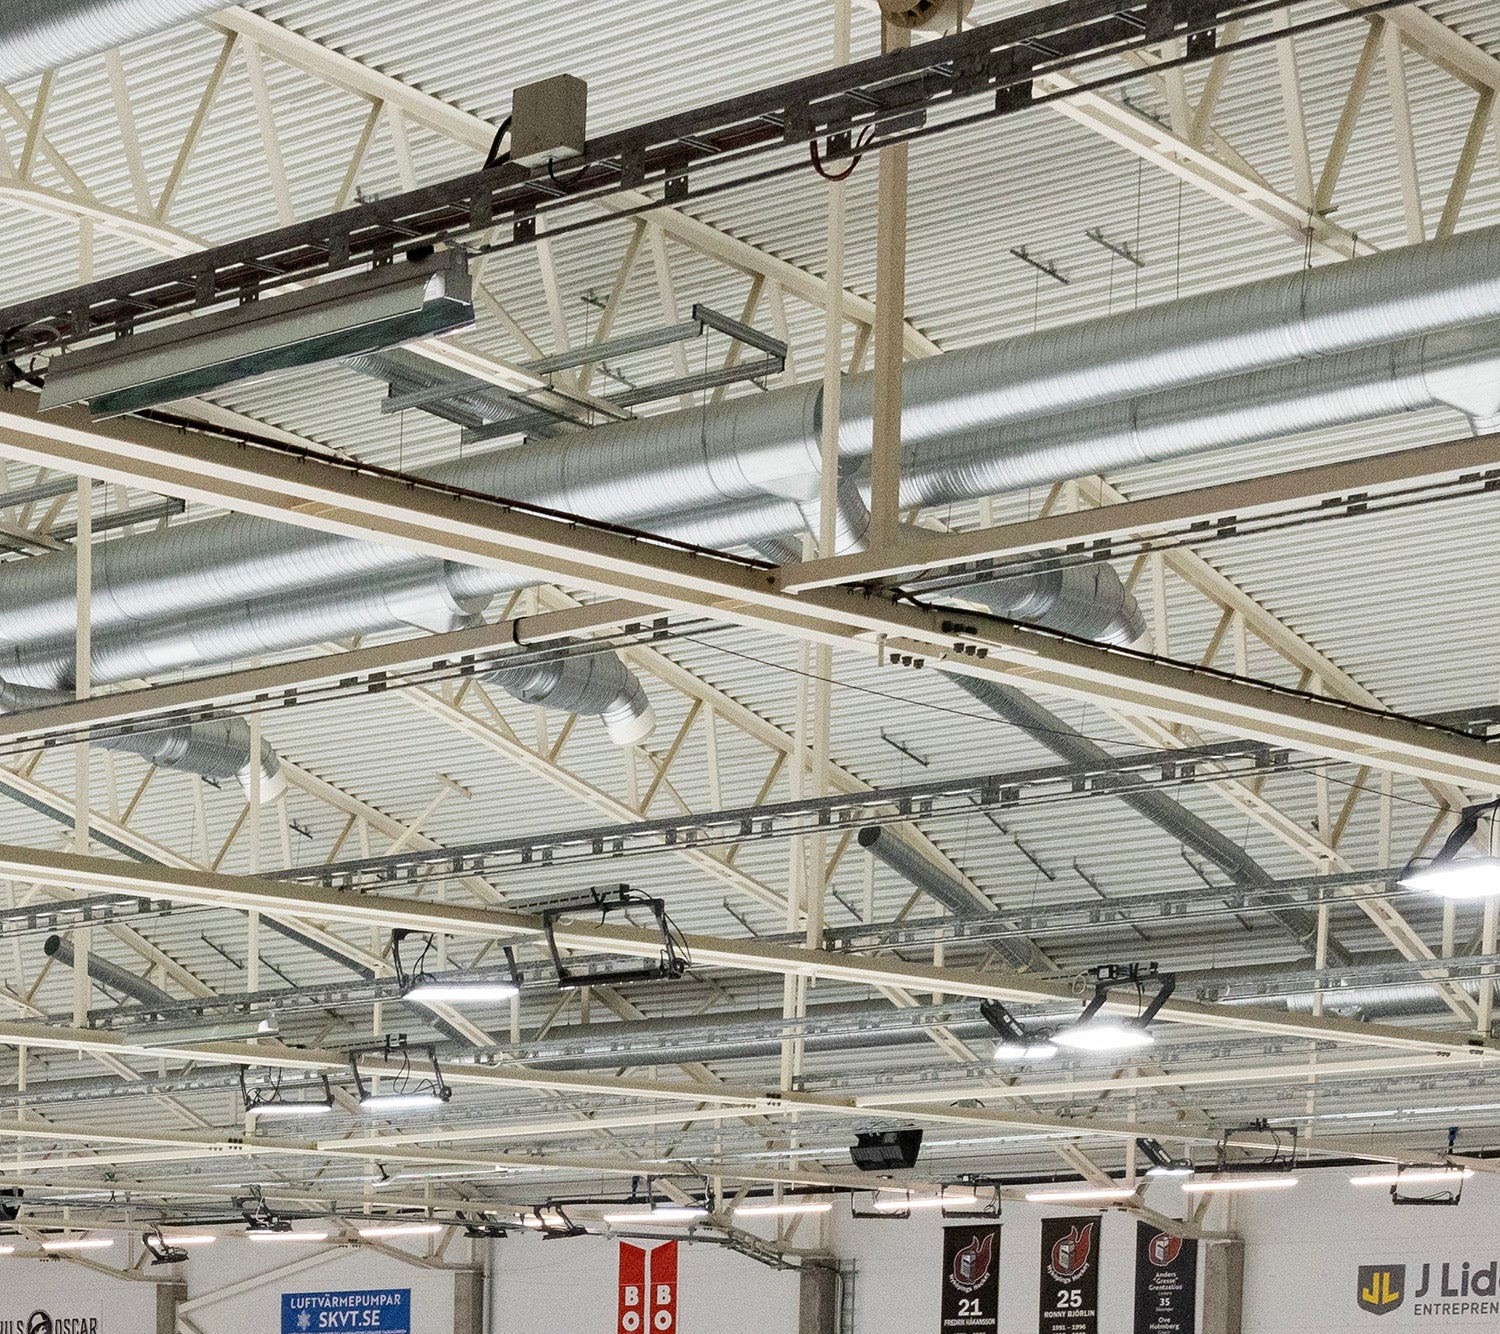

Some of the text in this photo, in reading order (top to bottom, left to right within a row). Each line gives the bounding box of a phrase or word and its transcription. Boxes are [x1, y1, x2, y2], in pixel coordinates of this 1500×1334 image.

[1414, 1263, 1431, 1298] J
[290, 1293, 401, 1309] LUFTVÄRMEPUMPAR
[958, 1298, 983, 1317] 21
[1056, 1289, 1083, 1309] 25
[1159, 1297, 1171, 1307] 35
[318, 1309, 381, 1328] SKVT.SE
